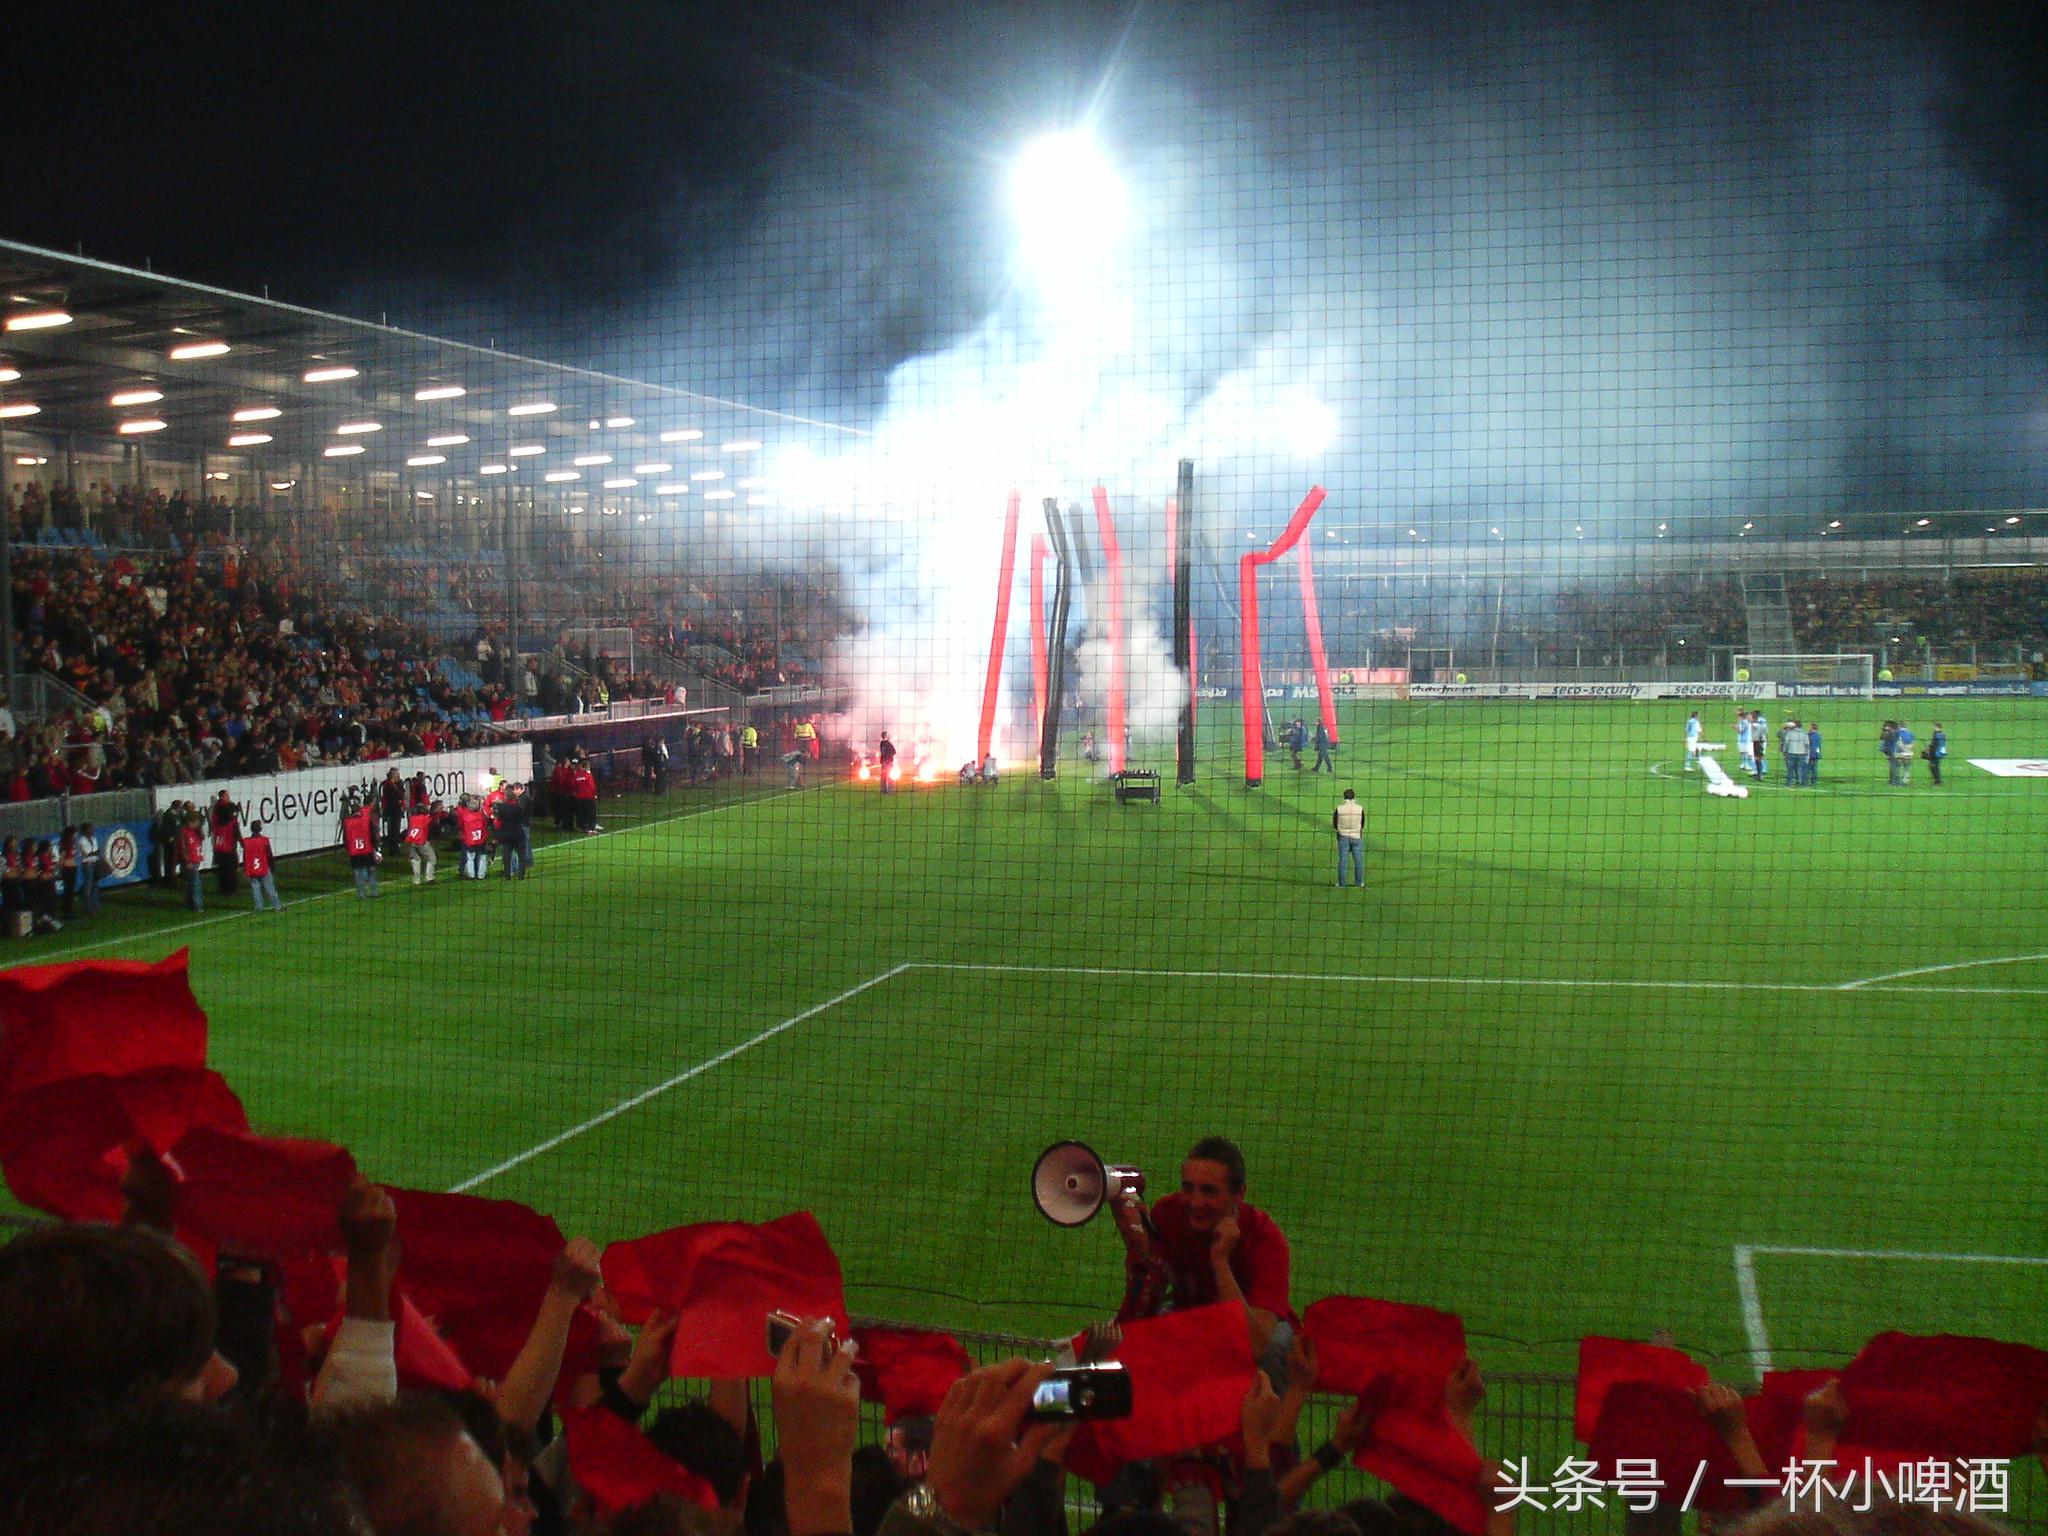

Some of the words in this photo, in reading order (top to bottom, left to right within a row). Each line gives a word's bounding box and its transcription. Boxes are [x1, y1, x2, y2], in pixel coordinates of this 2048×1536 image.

[1551, 685, 1642, 697] seco-security
[1673, 684, 1765, 697] seco-secrity
[354, 839, 364, 849] 15
